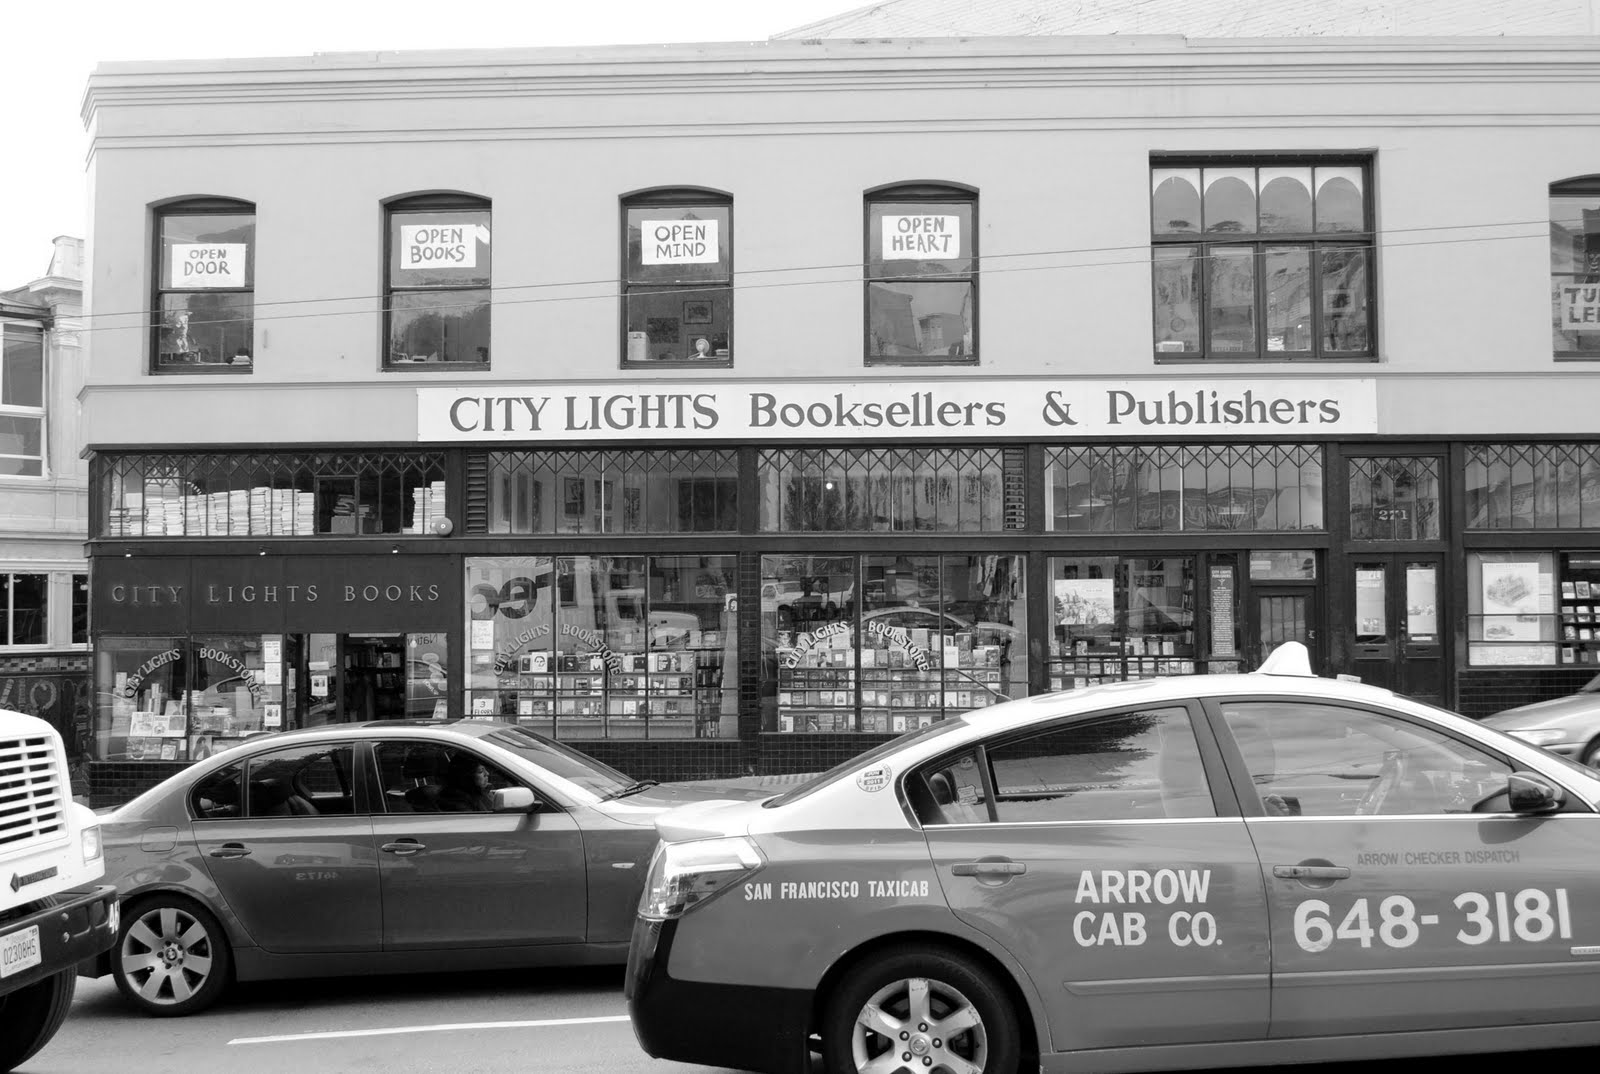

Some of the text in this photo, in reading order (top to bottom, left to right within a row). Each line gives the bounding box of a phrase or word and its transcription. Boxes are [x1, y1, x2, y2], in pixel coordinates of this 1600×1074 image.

[655, 225, 706, 242] OPEN
[897, 217, 945, 233] OPEN
[415, 228, 463, 244] OPEN
[892, 233, 952, 253] HEART
[190, 249, 227, 259] OPEN
[410, 245, 466, 263] BOOKS
[656, 242, 706, 258] MIND
[184, 261, 231, 276] DOOR
[1564, 287, 1600, 304] TU
[1569, 306, 1600, 323] LE
[449, 389, 1342, 432] CITY LIGHTS Booksellers & Publishers
[1379, 510, 1408, 520] 271
[112, 584, 440, 602] CITY LIGHTS BOOKS
[493, 648, 513, 676] CITY
[509, 623, 550, 652] LIGHTS
[562, 623, 621, 676] BOOKSTORE
[785, 620, 930, 673] CITY LIGHTS BOOKSTORE
[125, 647, 261, 698] CITY LIGHTS BOOKSTORE
[479, 700, 486, 708] 3
[1357, 850, 1520, 866] ARROW CHECKER DISPATCH
[744, 880, 929, 901] SAN FRANCISCO TAXICAB
[1074, 868, 1211, 904] ARROW
[1073, 911, 1223, 947] CAB CO.
[1293, 888, 1571, 953] 648- 3181
